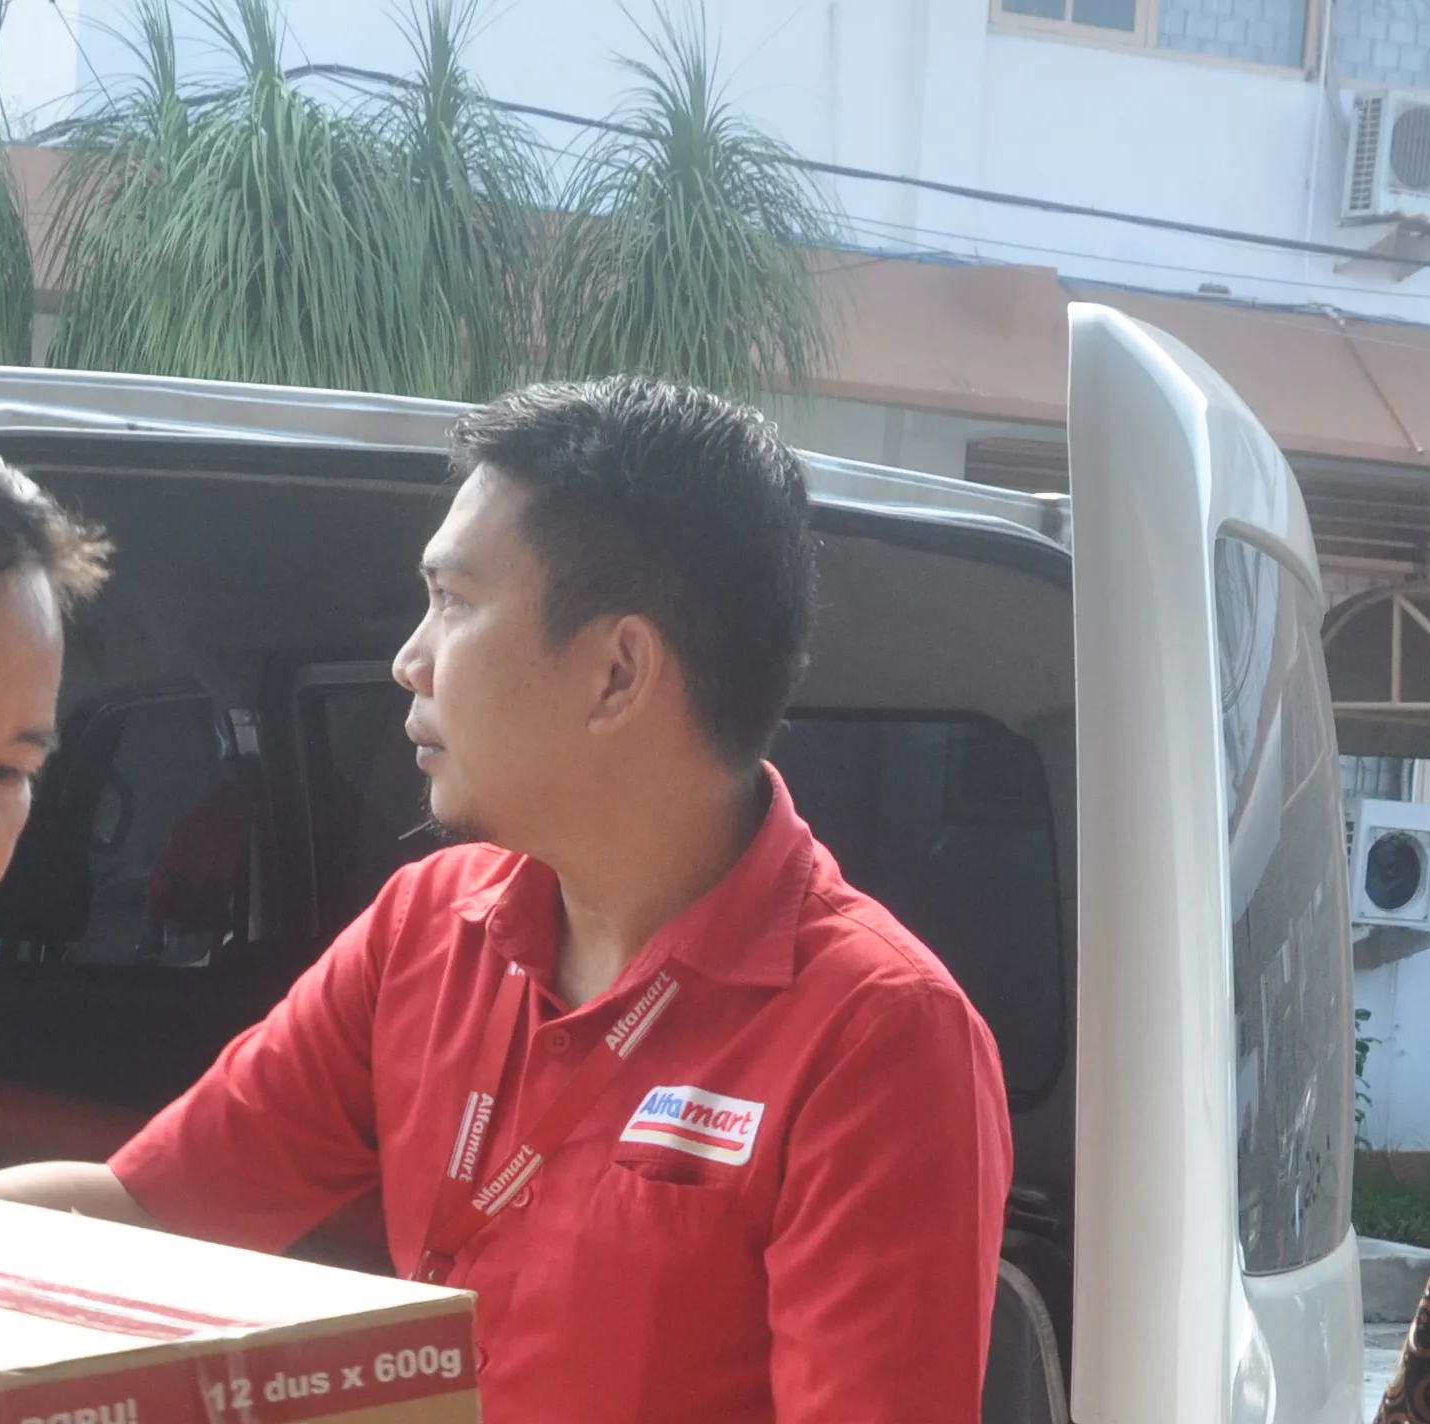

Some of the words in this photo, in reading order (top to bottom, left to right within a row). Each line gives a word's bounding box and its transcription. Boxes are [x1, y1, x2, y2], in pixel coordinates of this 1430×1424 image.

[604, 969, 672, 1051] Alfamart
[458, 1092, 494, 1184] Alfamart
[639, 1091, 754, 1135] Alfamart
[472, 1144, 534, 1211] Alfamart
[206, 1377, 254, 1411] 12
[263, 1371, 330, 1403] dus
[340, 1364, 365, 1390] x
[374, 1344, 462, 1383] 600g
